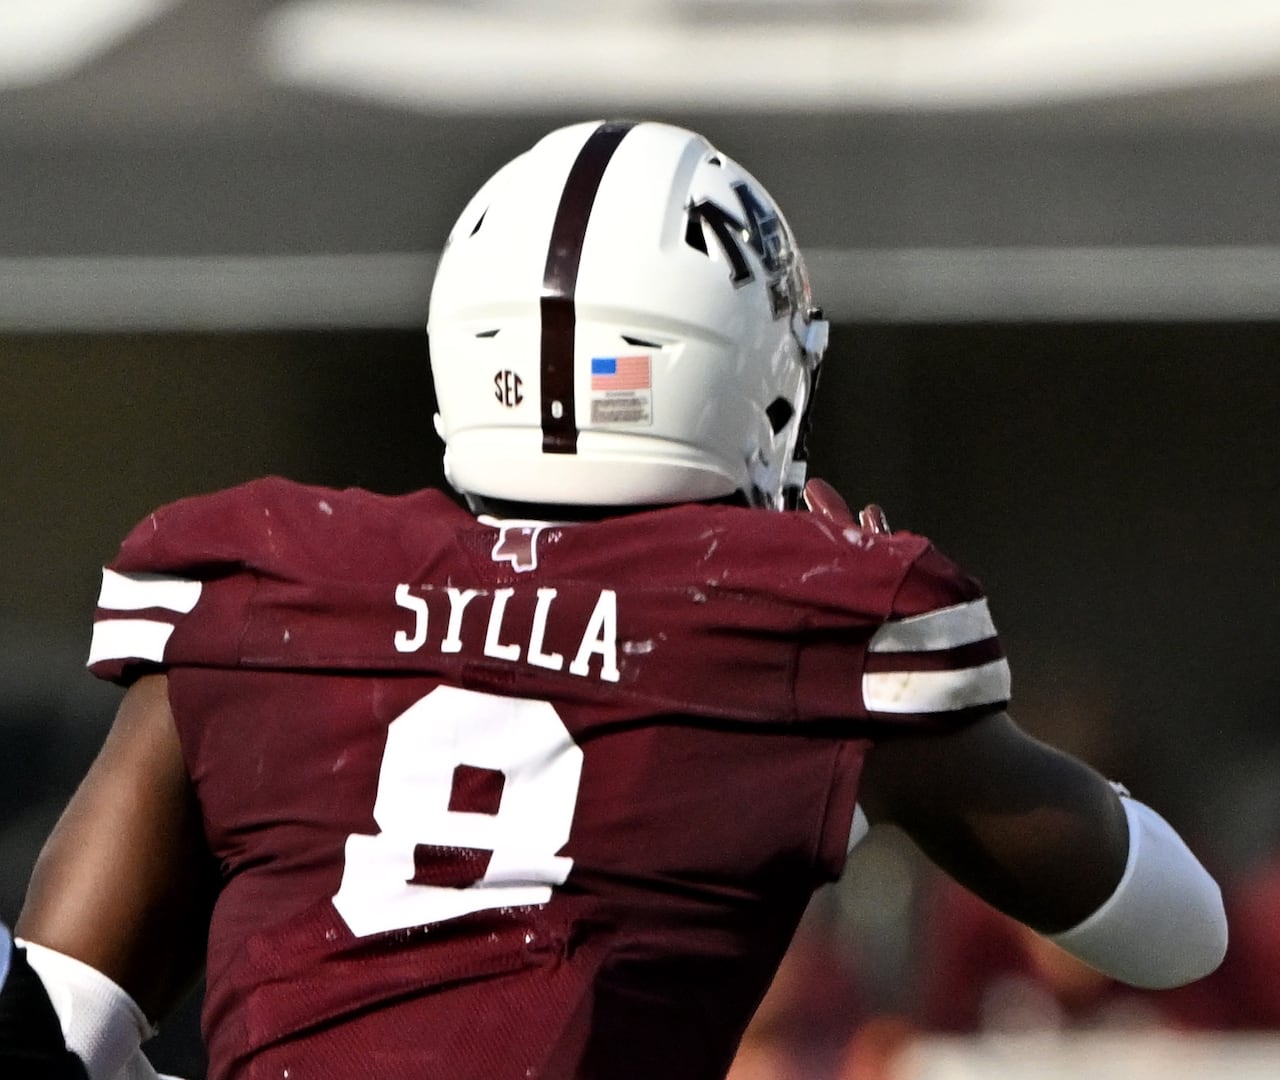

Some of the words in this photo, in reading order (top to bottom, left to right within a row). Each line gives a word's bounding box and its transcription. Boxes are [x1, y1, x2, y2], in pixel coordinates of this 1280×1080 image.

[494, 370, 523, 408] SEC
[395, 583, 620, 683] SYLLA
[332, 685, 584, 938] 8
